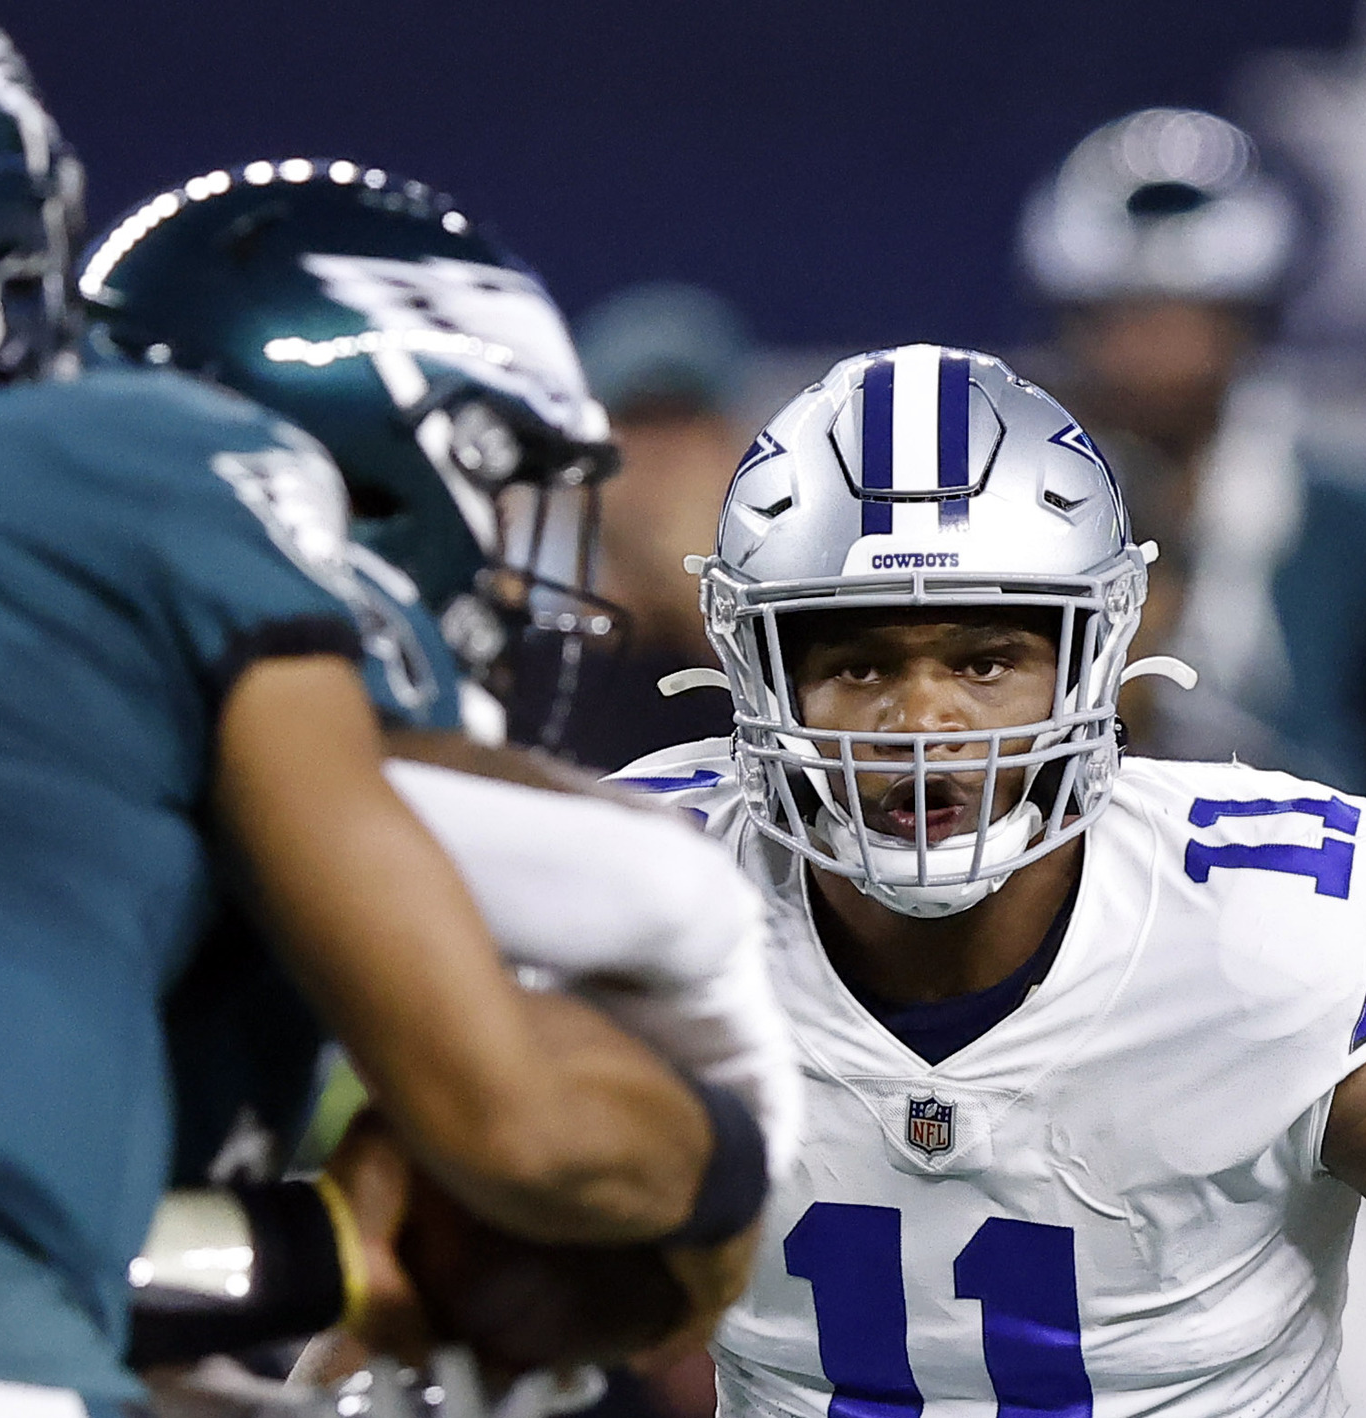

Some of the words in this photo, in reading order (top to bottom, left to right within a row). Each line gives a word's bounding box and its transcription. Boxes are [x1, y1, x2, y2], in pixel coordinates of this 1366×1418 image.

[871, 552, 960, 570] COWBOYS
[1184, 795, 1362, 901] 11
[912, 1119, 948, 1149] NFL
